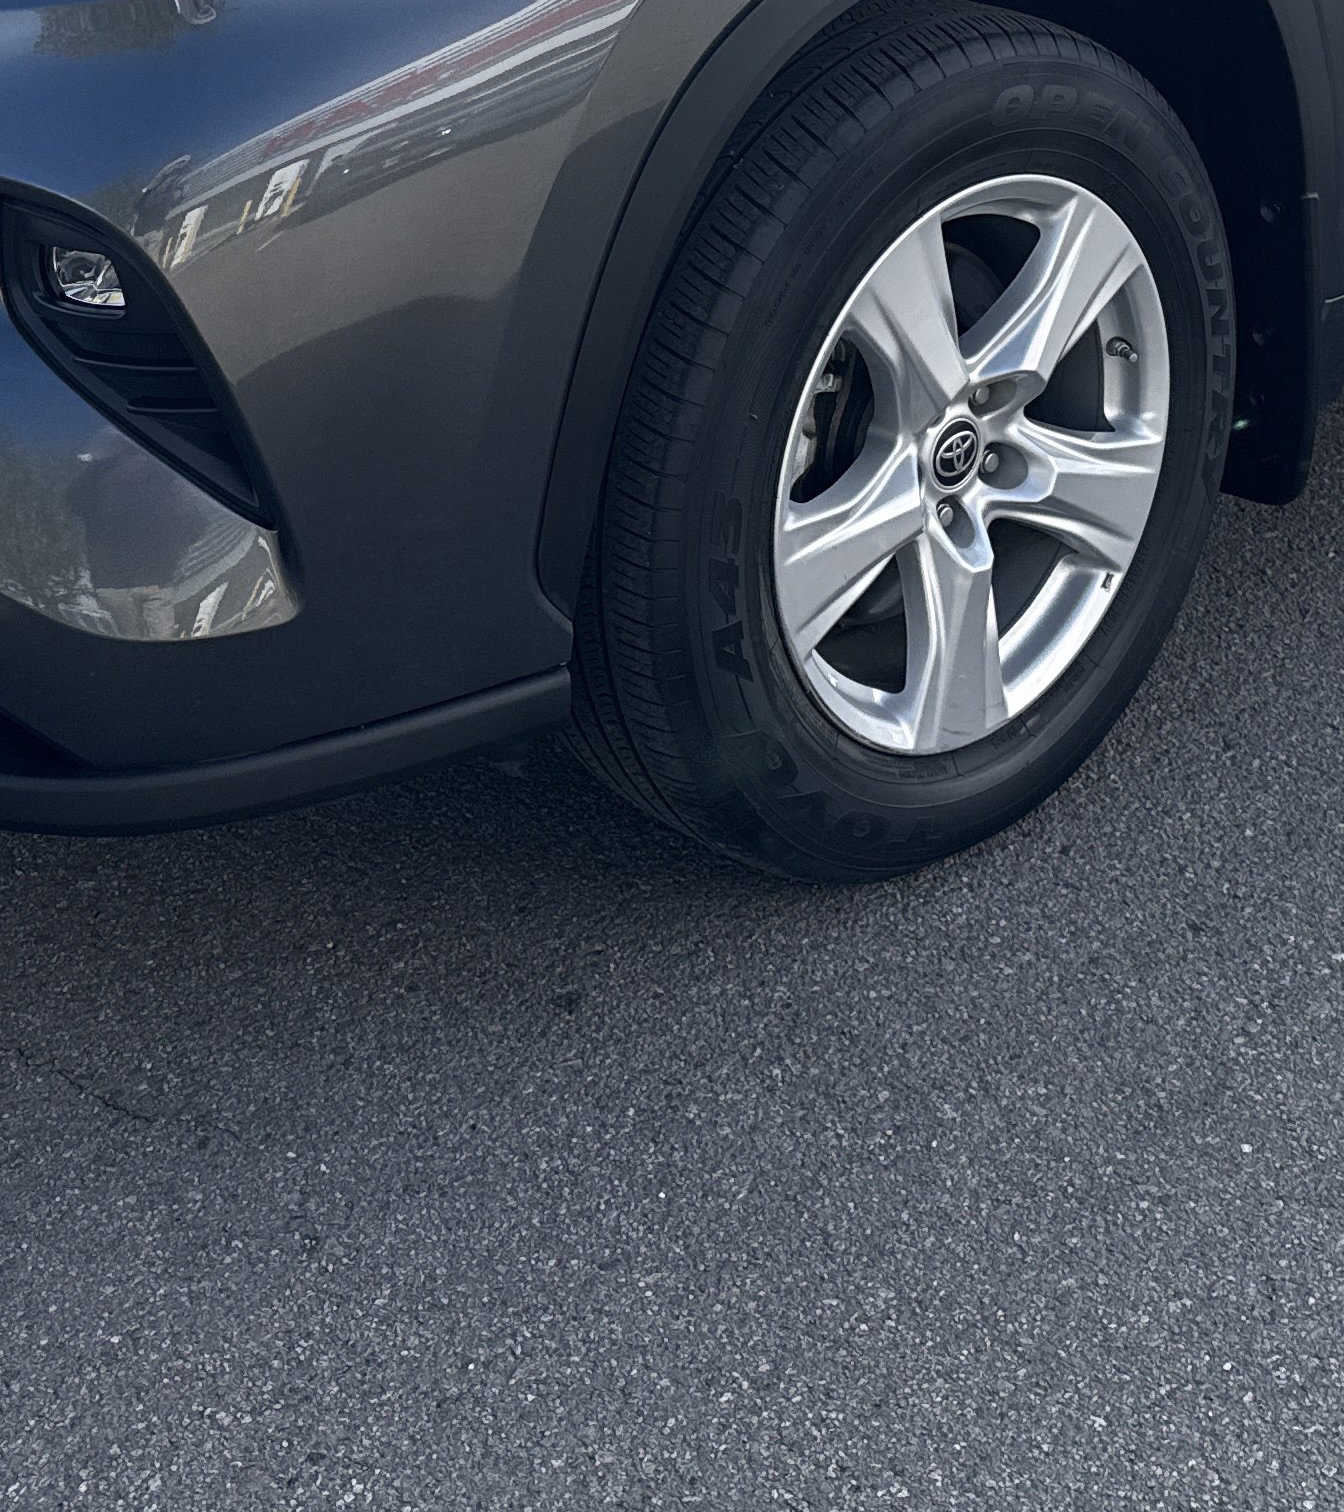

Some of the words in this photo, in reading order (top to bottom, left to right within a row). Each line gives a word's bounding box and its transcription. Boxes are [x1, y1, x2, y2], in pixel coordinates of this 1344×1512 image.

[991, 83, 1151, 154] OPEN
[1156, 152, 1233, 506] COUNTRY
[707, 489, 755, 683] A43
